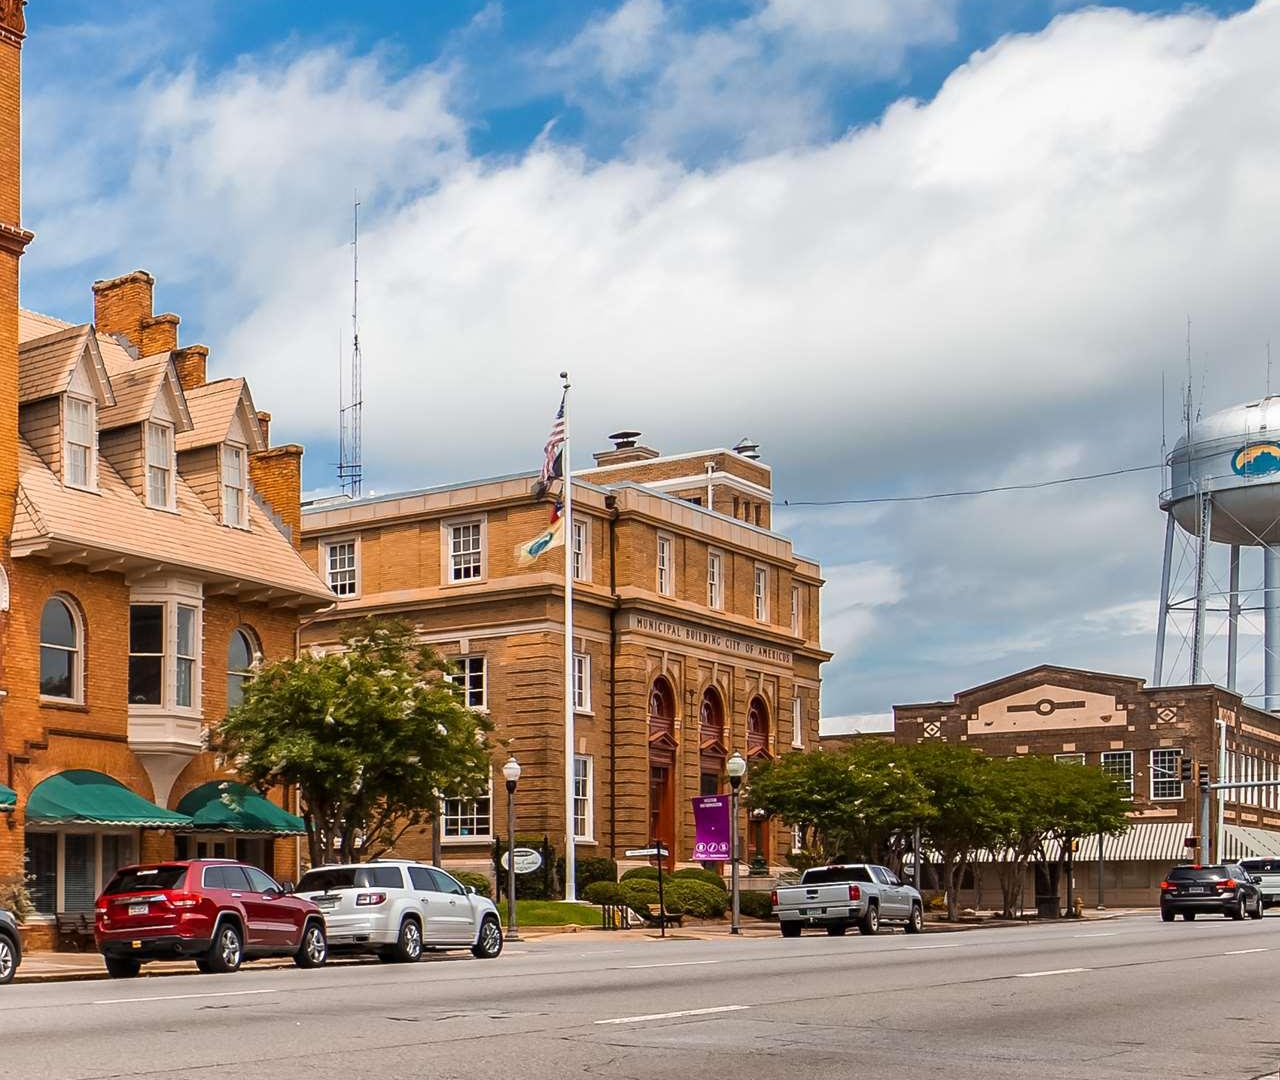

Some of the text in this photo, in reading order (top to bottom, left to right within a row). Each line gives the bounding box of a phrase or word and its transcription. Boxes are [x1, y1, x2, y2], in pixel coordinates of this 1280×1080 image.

[636, 617, 790, 663] MUNICIPAL BUILDING CITY OF AMERICUS
